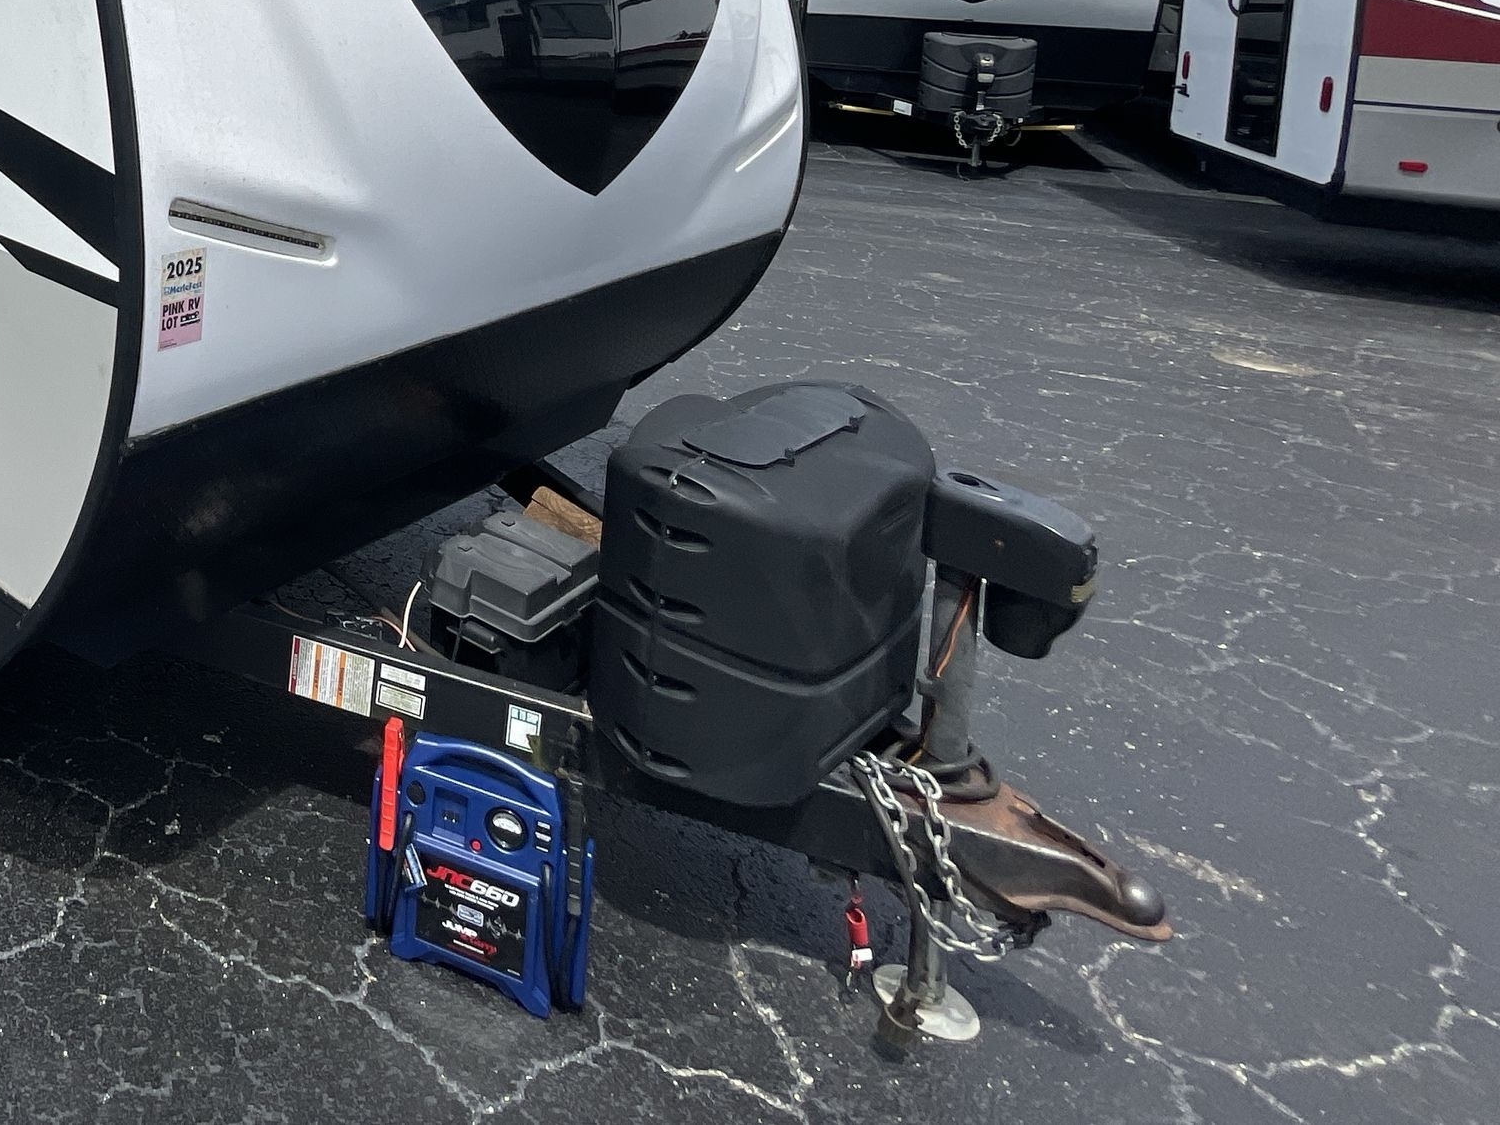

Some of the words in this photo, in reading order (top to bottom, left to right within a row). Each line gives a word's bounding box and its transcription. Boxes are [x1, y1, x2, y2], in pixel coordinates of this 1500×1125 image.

[166, 256, 203, 280] 2025
[162, 300, 185, 317] PINK
[188, 296, 201, 312] RV
[161, 316, 179, 332] LOT
